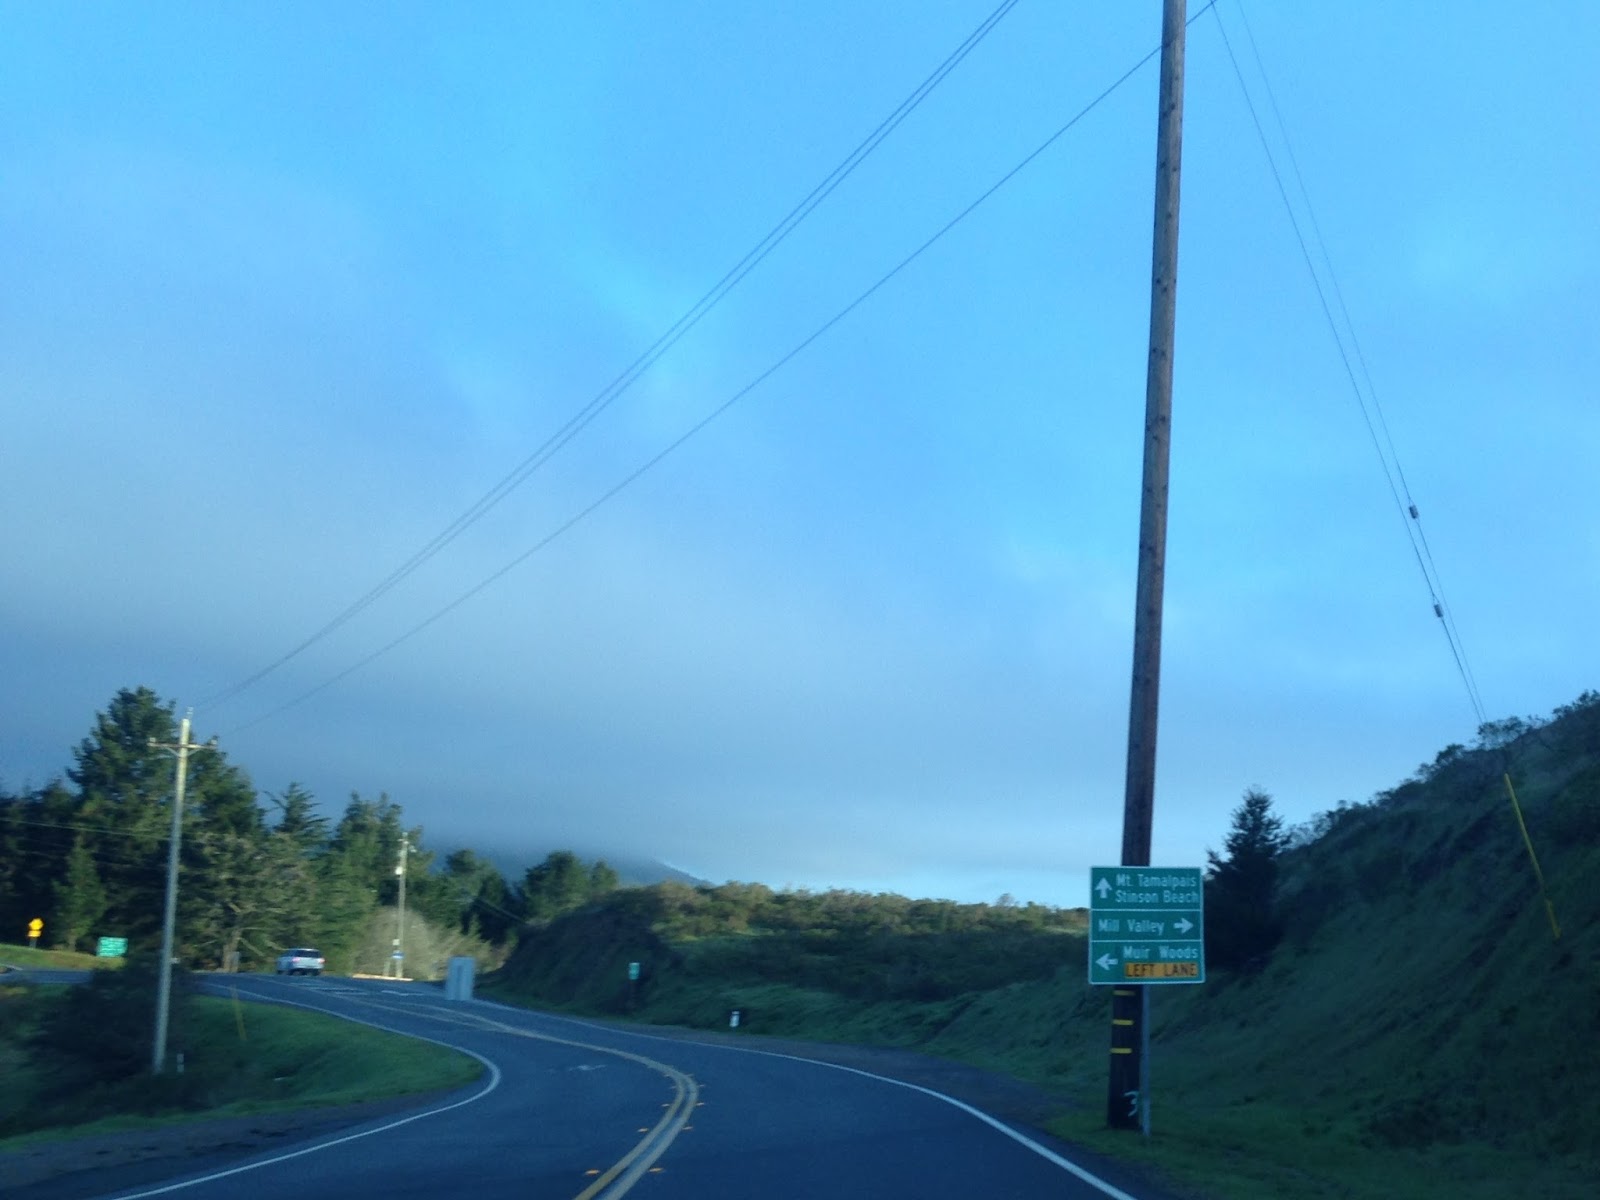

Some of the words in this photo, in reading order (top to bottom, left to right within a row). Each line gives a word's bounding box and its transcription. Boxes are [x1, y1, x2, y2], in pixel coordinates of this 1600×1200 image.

[1137, 873, 1197, 890] Tamalpais
[1115, 889, 1159, 903] Stinson
[1163, 889, 1199, 903] Beach
[1098, 919, 1120, 932] Mill
[1127, 919, 1165, 936] Valley
[1123, 945, 1151, 959] Muir
[1158, 945, 1198, 959] Woods
[1126, 963, 1154, 978] LEFT
[1164, 962, 1197, 977] LANE
